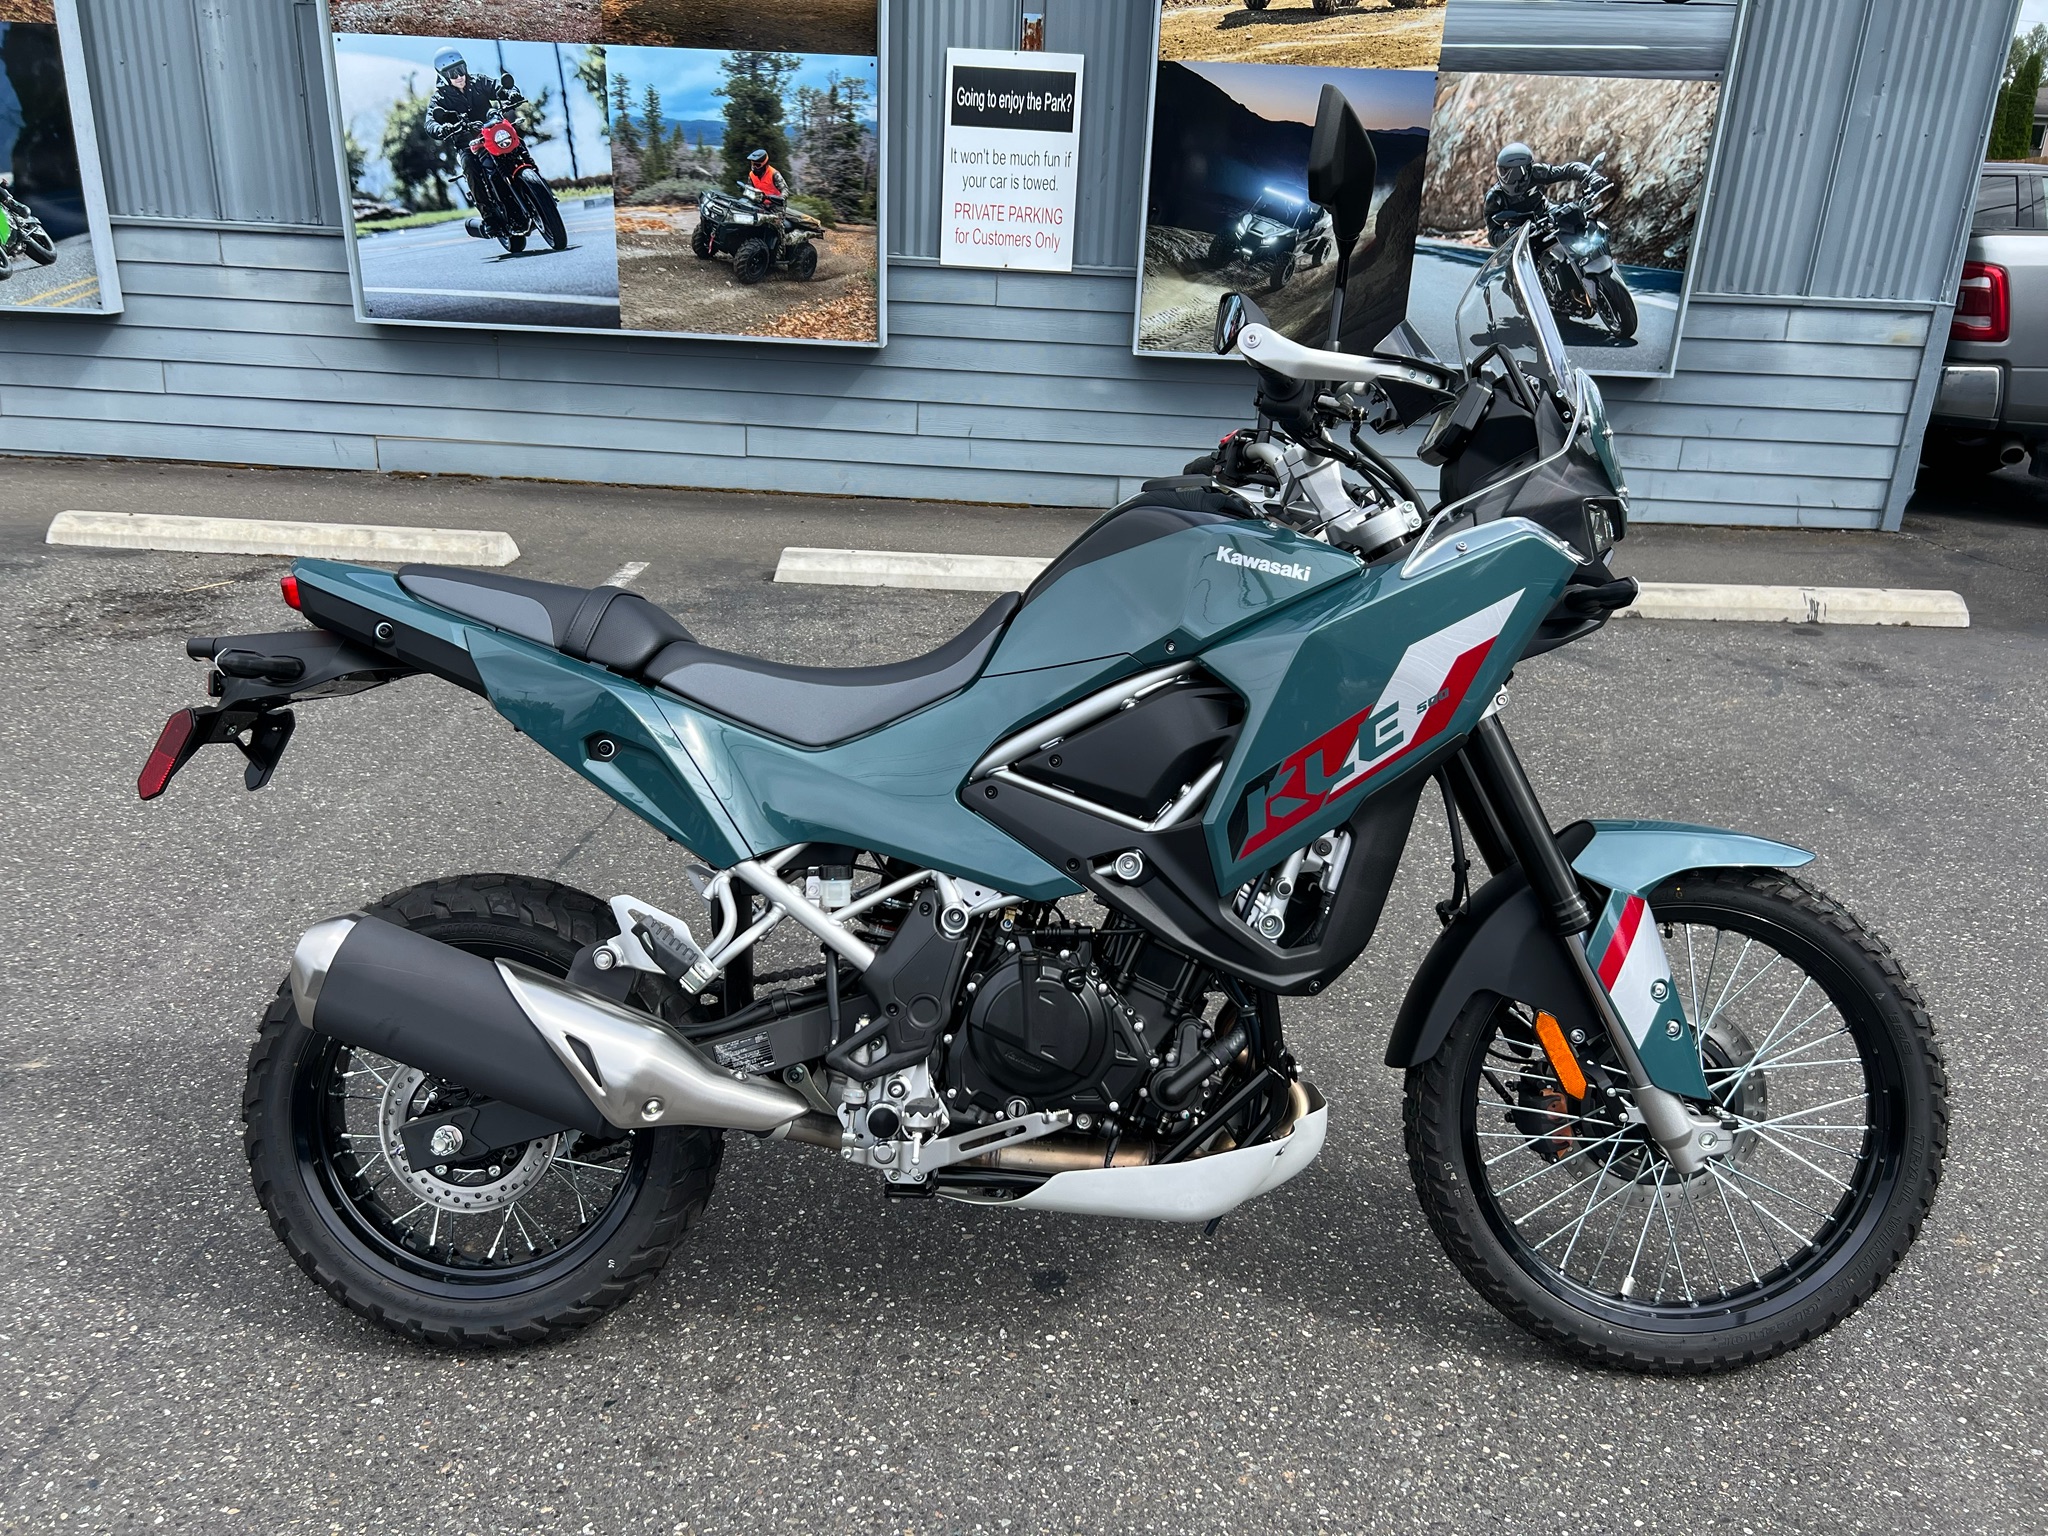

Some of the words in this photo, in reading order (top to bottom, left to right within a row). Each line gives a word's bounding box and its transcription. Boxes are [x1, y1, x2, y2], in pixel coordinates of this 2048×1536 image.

[956, 87, 986, 112] Going
[987, 91, 997, 108] to
[999, 91, 1025, 114] enjoy
[1026, 91, 1042, 111] the
[1044, 92, 1073, 113] Park?
[950, 147, 957, 163] It
[960, 148, 990, 164] won't
[993, 149, 1006, 165] be
[1009, 150, 1040, 167] much
[1043, 151, 1060, 167] fun
[1064, 151, 1072, 168] if
[962, 174, 987, 191] your
[989, 175, 1007, 189] car
[1010, 173, 1020, 189] is
[1023, 174, 1059, 191] towed.
[954, 202, 1005, 222] PRIVATE
[1008, 205, 1063, 225] PARKING
[954, 227, 969, 244] for
[972, 228, 1032, 247] Customers
[1035, 231, 1061, 253] Only
[1216, 545, 1311, 582] Kawasaki
[1246, 700, 1405, 834] KLE
[1416, 687, 1450, 715] 500
[1897, 1134, 1926, 1205] TRAIL
